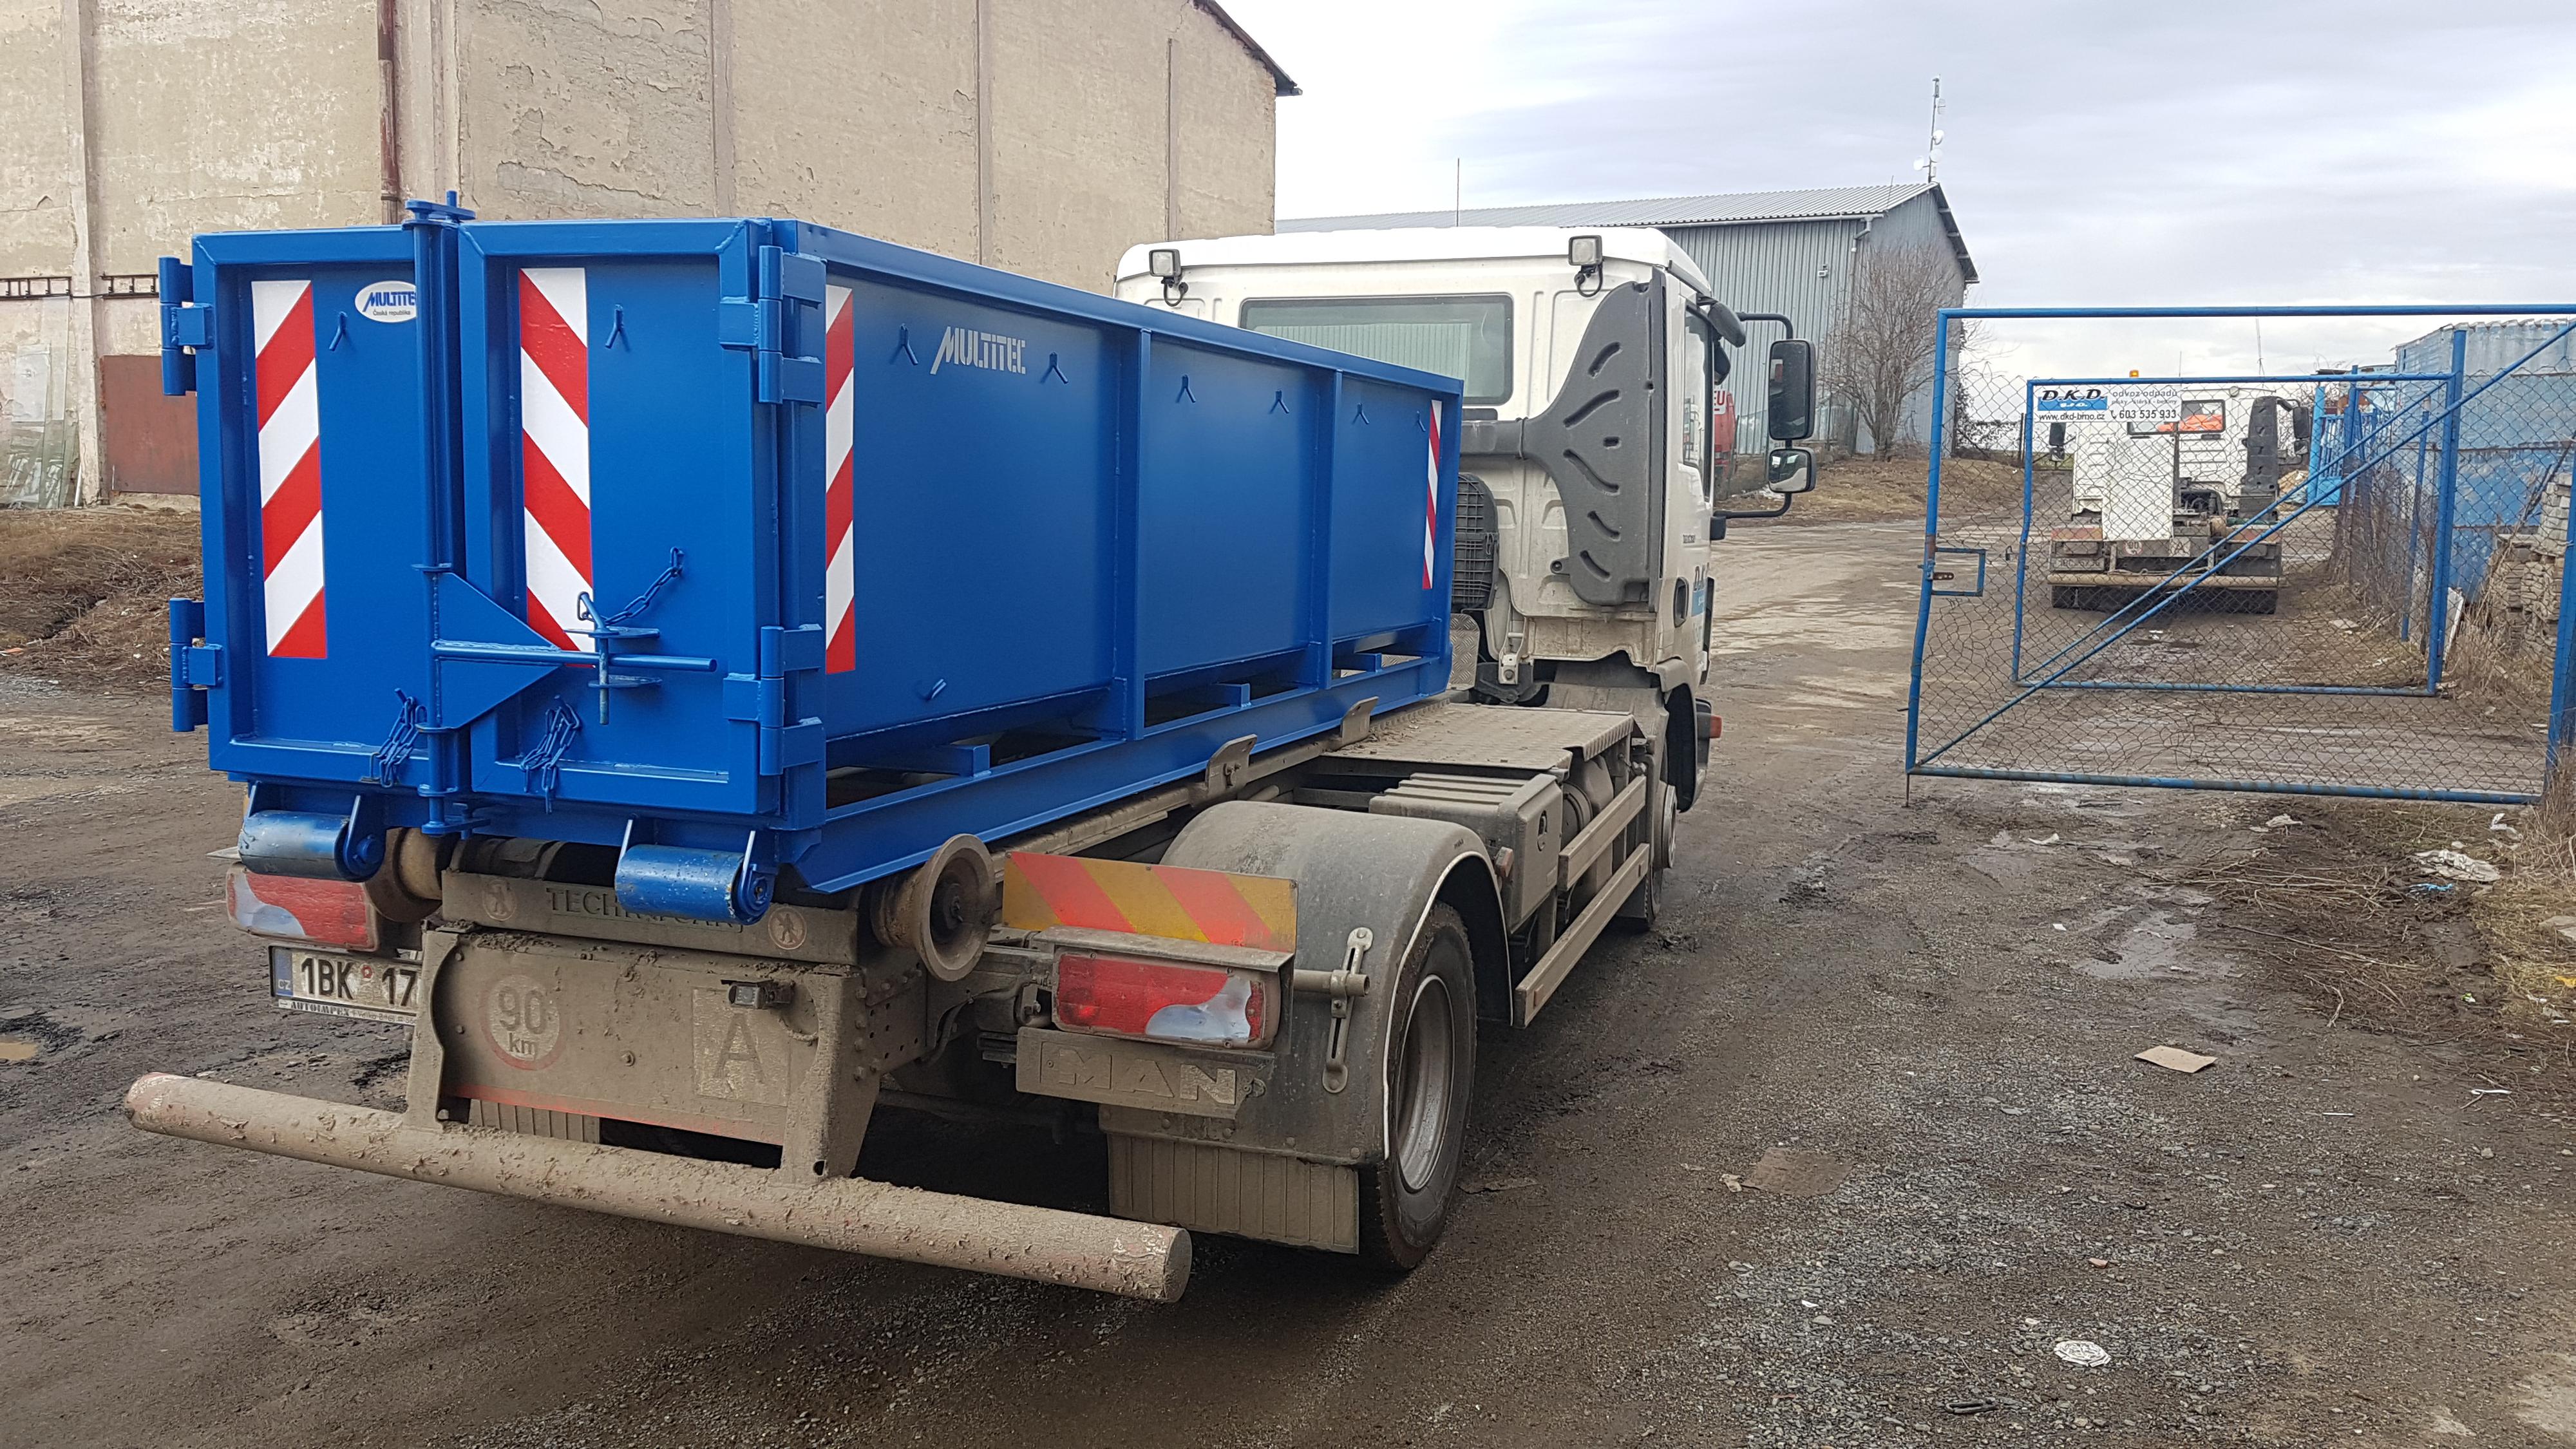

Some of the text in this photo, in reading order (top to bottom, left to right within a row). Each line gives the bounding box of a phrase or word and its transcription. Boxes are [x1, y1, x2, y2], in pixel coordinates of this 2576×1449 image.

[362, 291, 416, 312] MULTITE
[930, 326, 1026, 375] MULTITEC
[2042, 389, 2105, 401] D.K.D.
[2119, 409, 2176, 419] 603 535 933
[278, 979, 291, 990] CZ
[301, 957, 355, 999] 1BK
[291, 1001, 349, 1017] AUTOIMPEX
[498, 985, 546, 1035] 90
[508, 1032, 538, 1056] km
[713, 1012, 766, 1084] A
[1057, 1047, 1237, 1105] MAN
